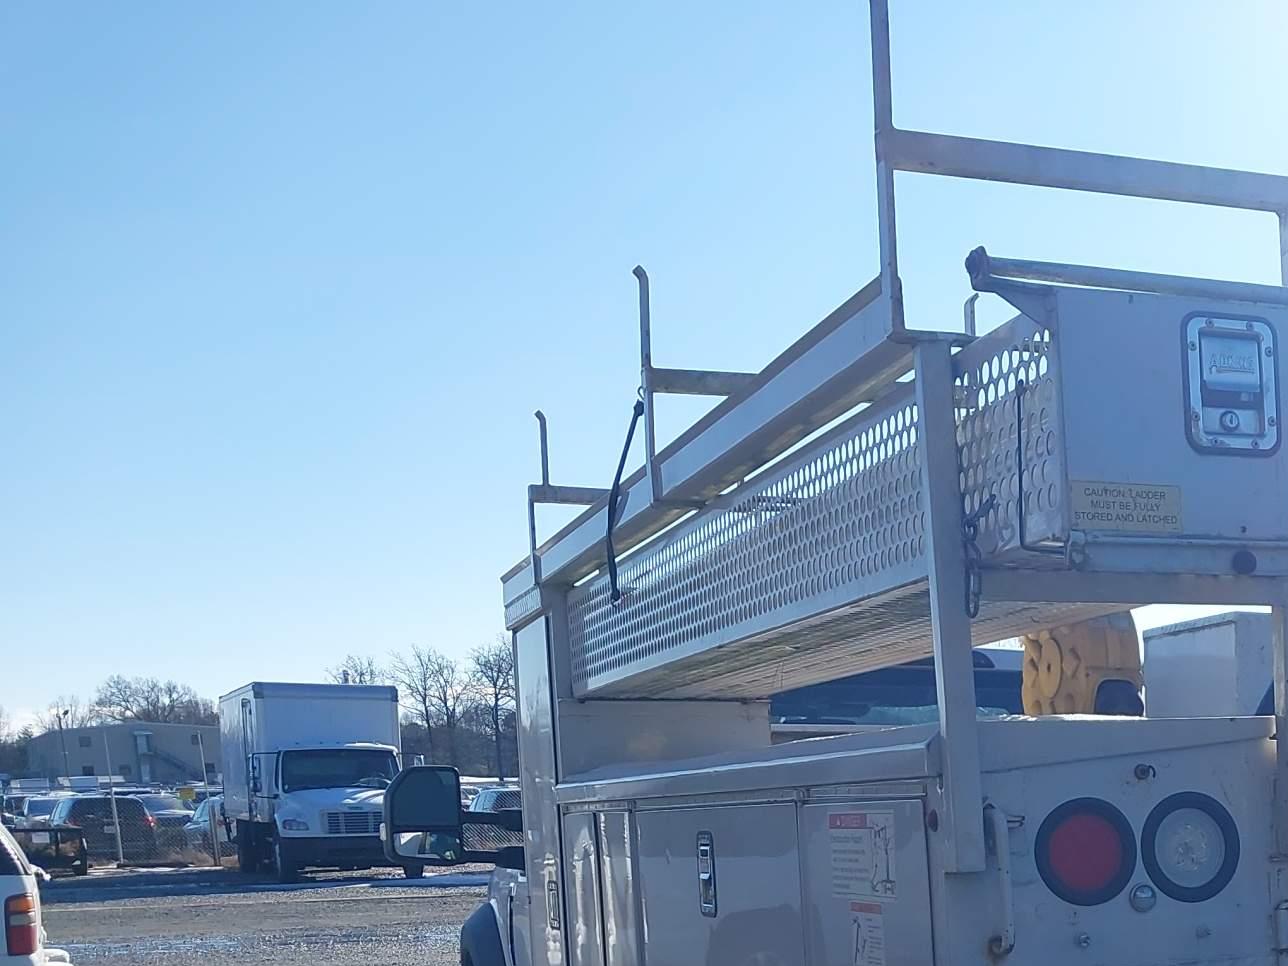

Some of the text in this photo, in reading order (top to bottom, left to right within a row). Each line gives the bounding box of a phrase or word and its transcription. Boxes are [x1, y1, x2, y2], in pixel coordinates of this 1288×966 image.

[1130, 489, 1167, 501] LADDER
[1090, 499, 1161, 512] MUST BE FULLY
[1074, 511, 1178, 524] STORED AND LATCHED
